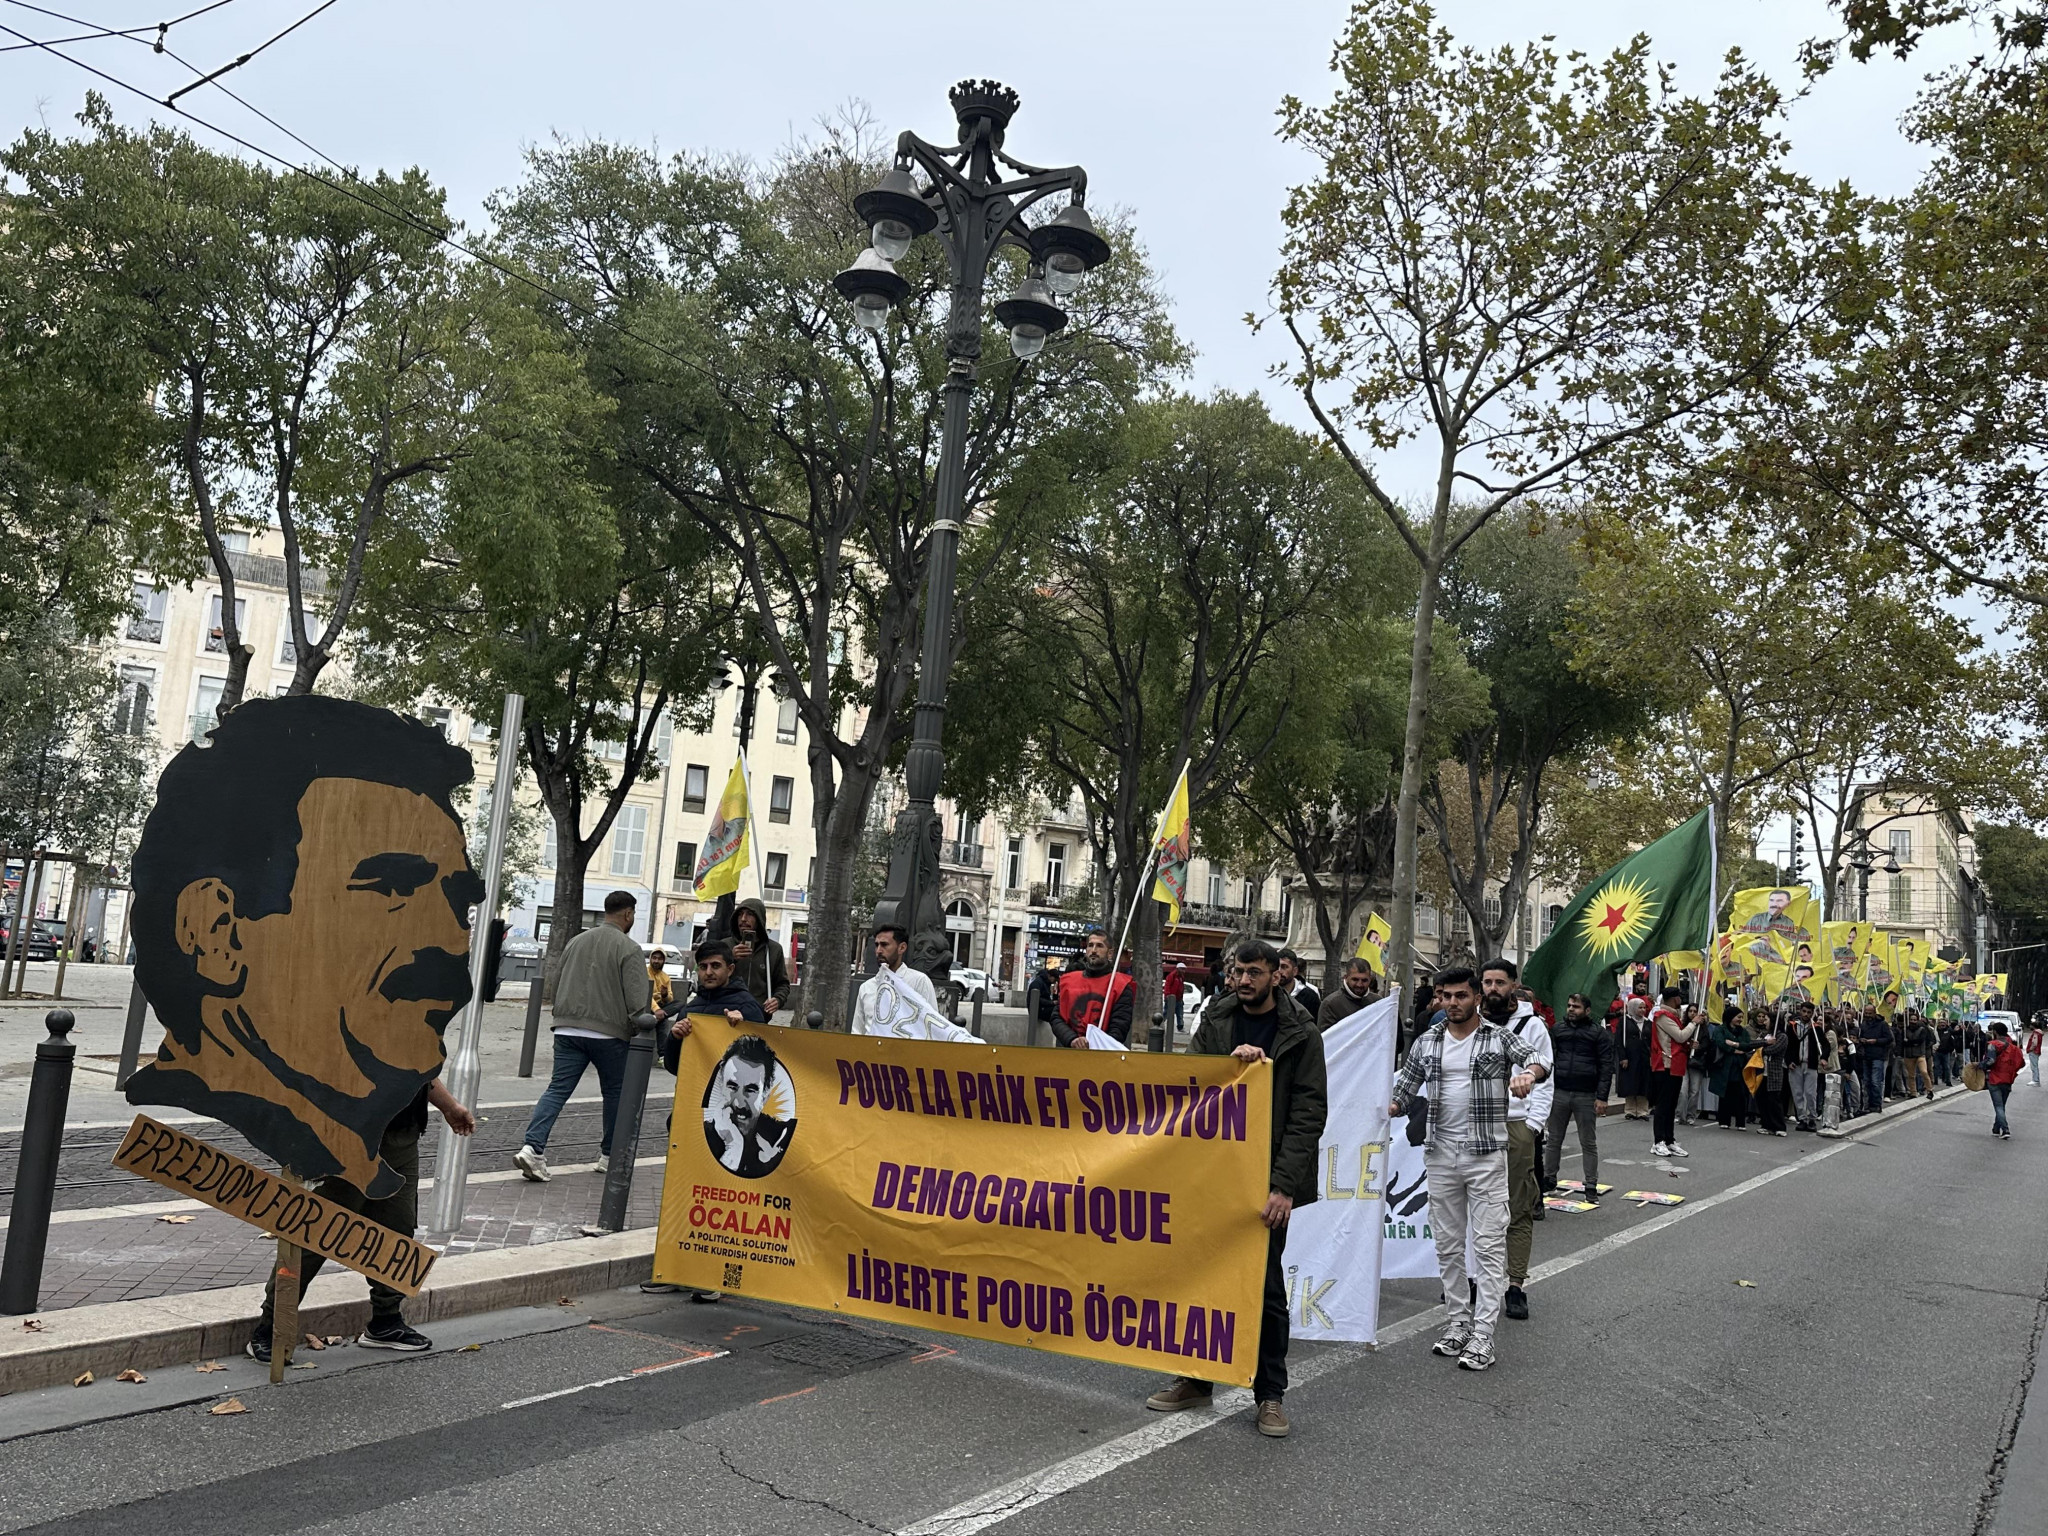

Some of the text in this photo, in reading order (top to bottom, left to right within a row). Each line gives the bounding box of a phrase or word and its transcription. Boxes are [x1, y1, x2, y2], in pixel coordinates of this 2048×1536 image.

[836, 1058, 914, 1113] POUR
[915, 1067, 957, 1118] LA
[1034, 1076, 1070, 1130] ET
[119, 1122, 437, 1288] FREEDOM FOR OCALAN
[689, 1198, 791, 1240] ÖCALAN
[692, 1184, 791, 1211] FREEDOM FOR
[871, 1161, 1172, 1245] DEMOCRATİQUE
[679, 1242, 796, 1267] TO THE KURDISH QUESTION
[689, 1231, 788, 1253] A POLITICAL SOLUTION
[976, 1275, 1074, 1338] POUR
[1084, 1282, 1236, 1365] ÖCALAN
